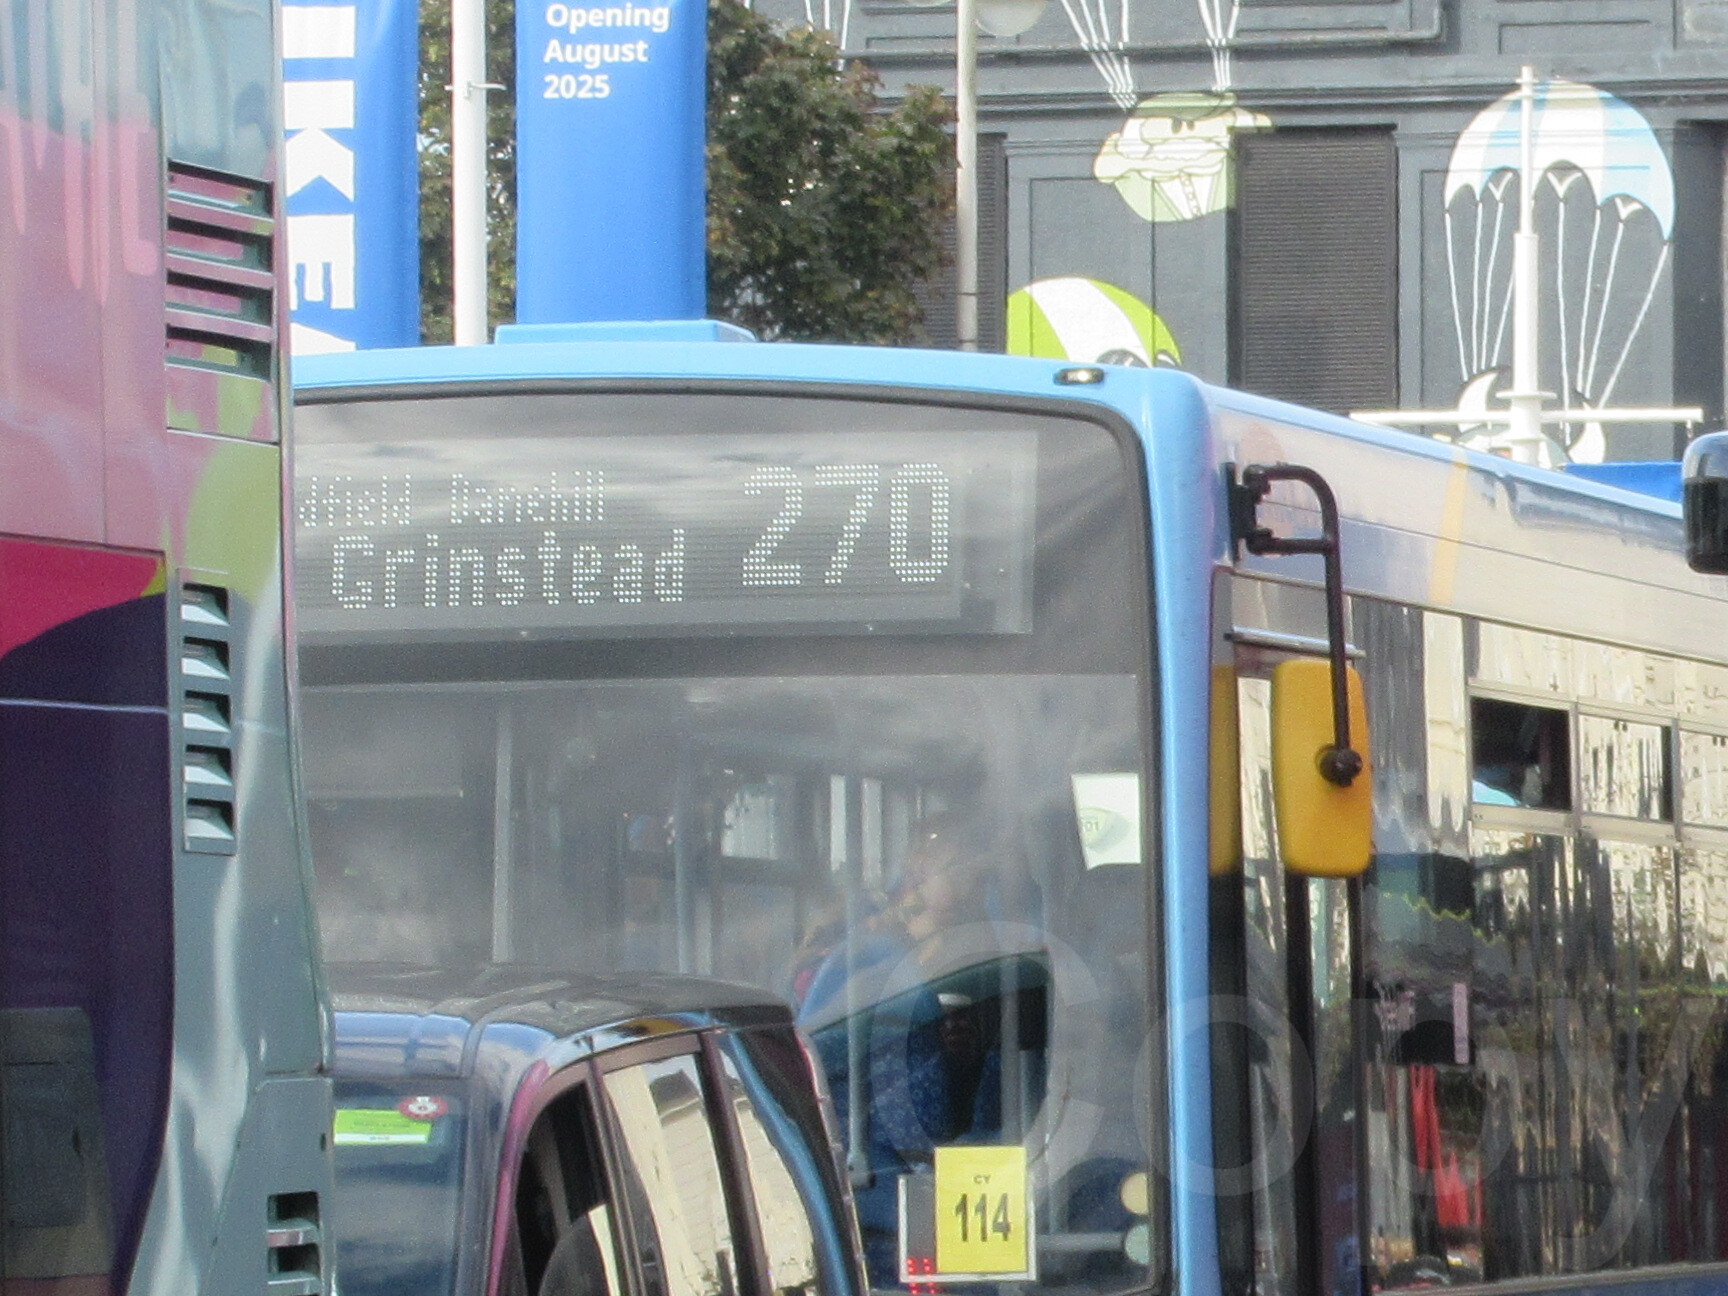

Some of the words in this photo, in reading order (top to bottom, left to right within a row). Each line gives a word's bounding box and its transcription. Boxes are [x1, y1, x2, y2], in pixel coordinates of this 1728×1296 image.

[546, 3, 670, 33] Opening
[543, 38, 649, 68] August
[543, 74, 612, 99] 2025
[740, 462, 950, 588] 270
[331, 526, 685, 609] Grinstead
[954, 1192, 1013, 1243] 114
